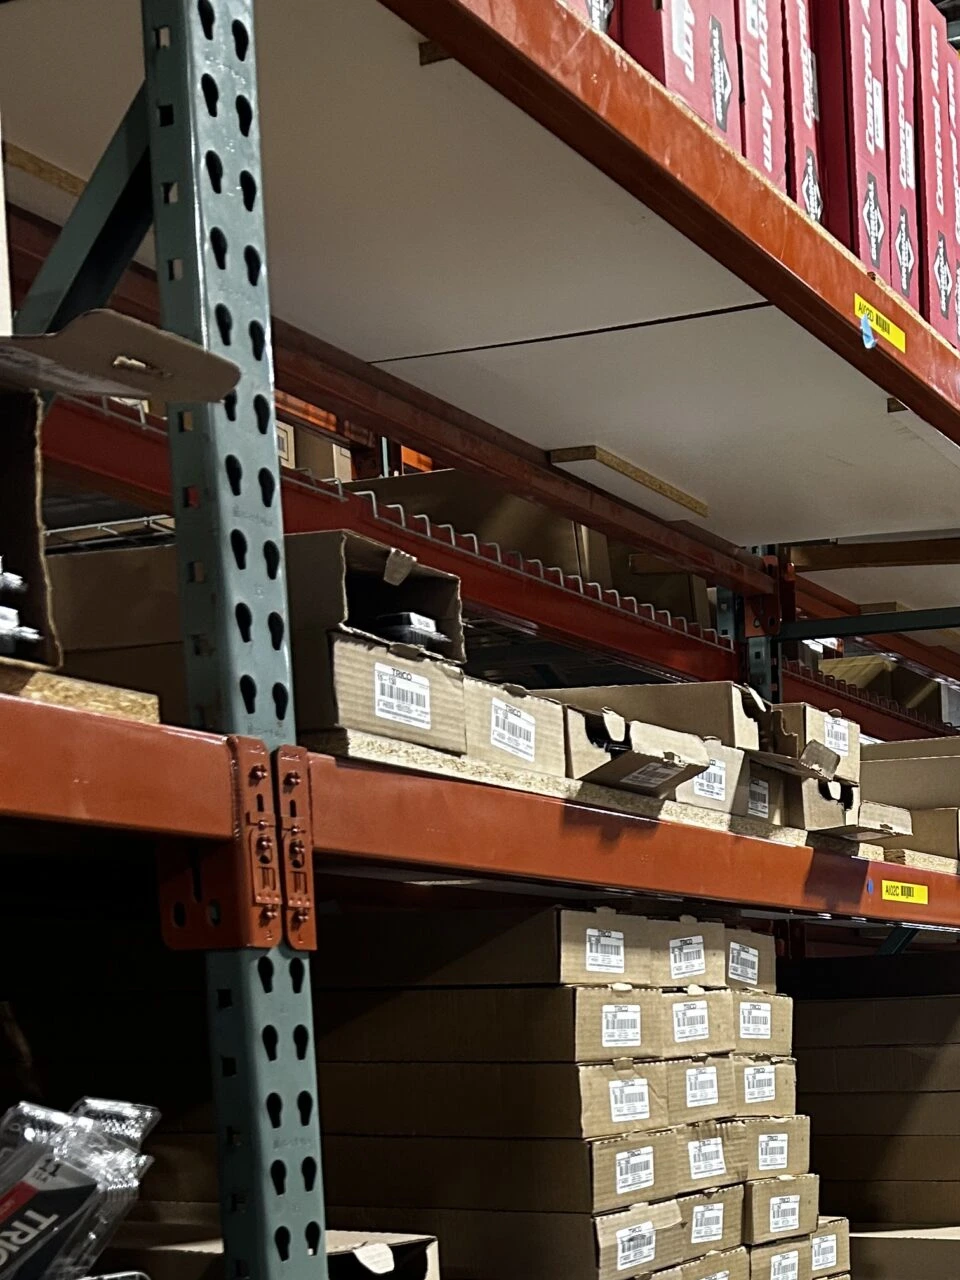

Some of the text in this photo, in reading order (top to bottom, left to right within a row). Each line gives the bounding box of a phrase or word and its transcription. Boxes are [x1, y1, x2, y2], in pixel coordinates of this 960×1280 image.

[862, 24, 875, 156] Control
[930, 24, 945, 216] Control Arm
[947, 63, 957, 129] Arm
[761, 89, 773, 173] Arm
[391, 667, 413, 682] TRICO
[504, 703, 522, 719] TRICO
[885, 885, 900, 897] AI02C
